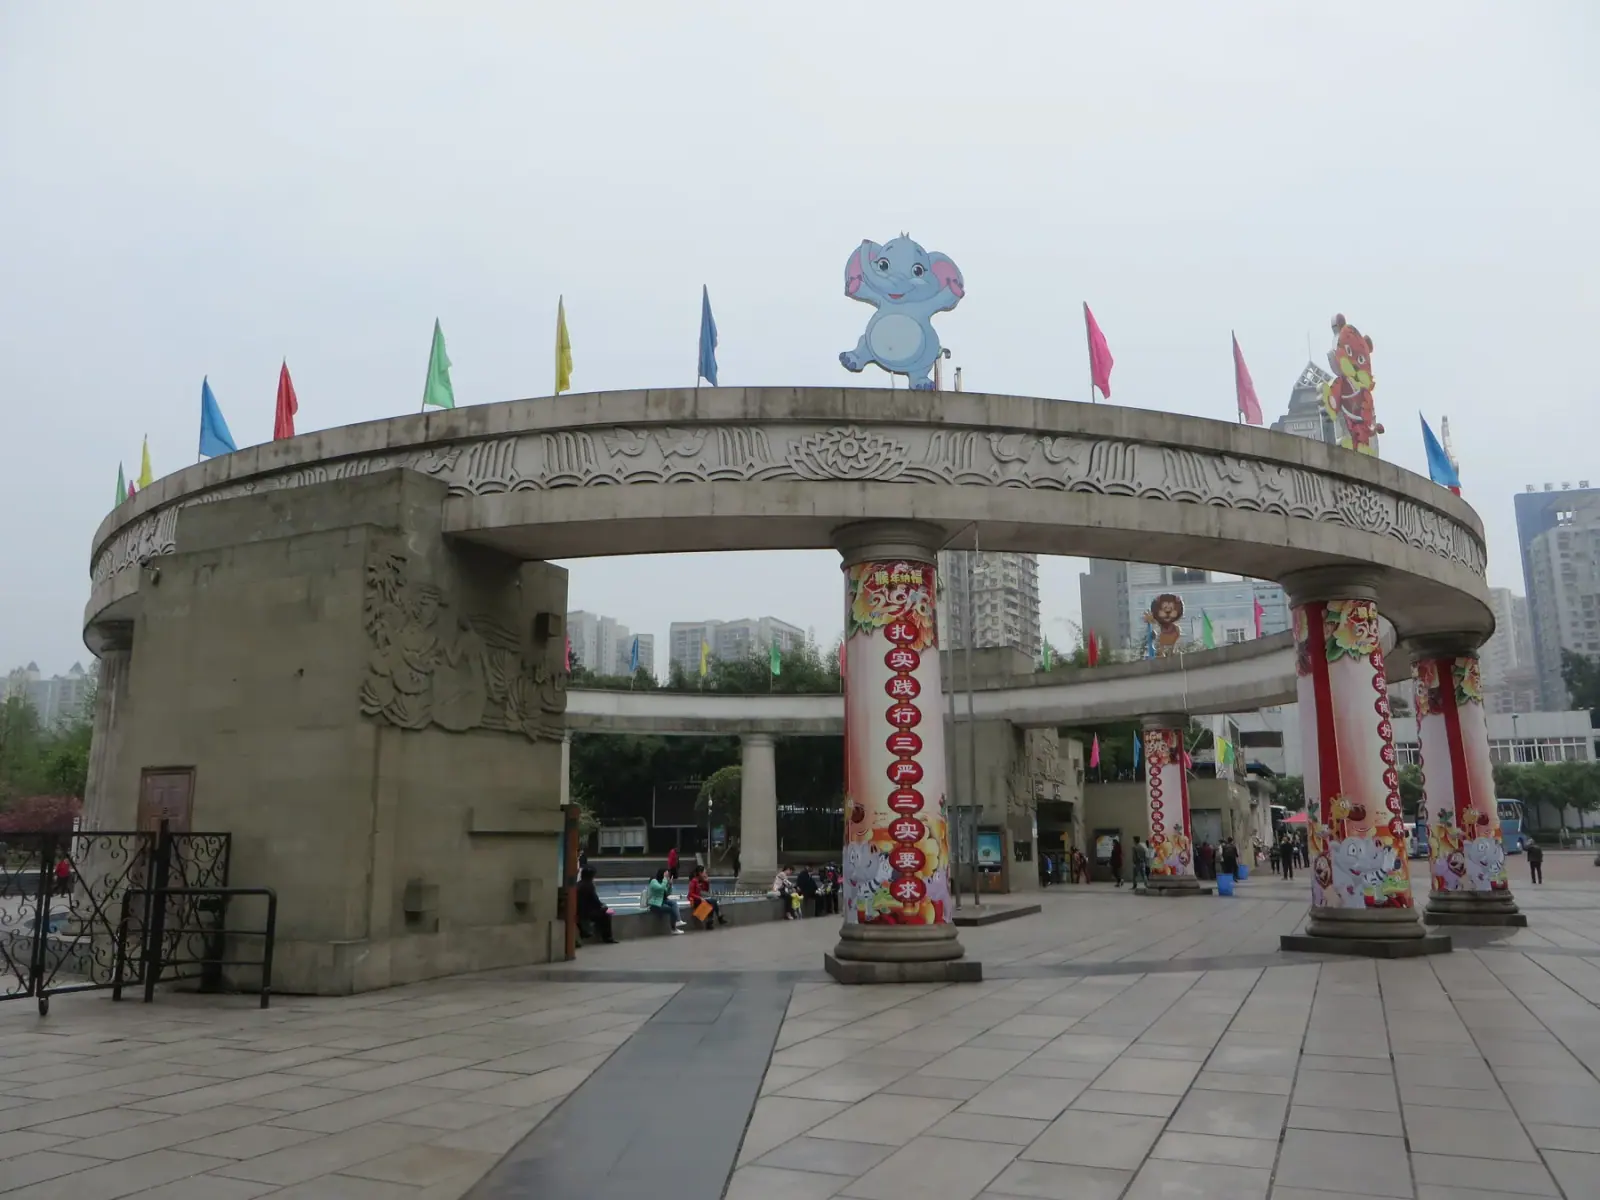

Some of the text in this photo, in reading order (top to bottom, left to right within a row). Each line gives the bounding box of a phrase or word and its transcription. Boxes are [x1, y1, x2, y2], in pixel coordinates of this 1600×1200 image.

[890, 624, 921, 899] 扎实践行三严三实要求
